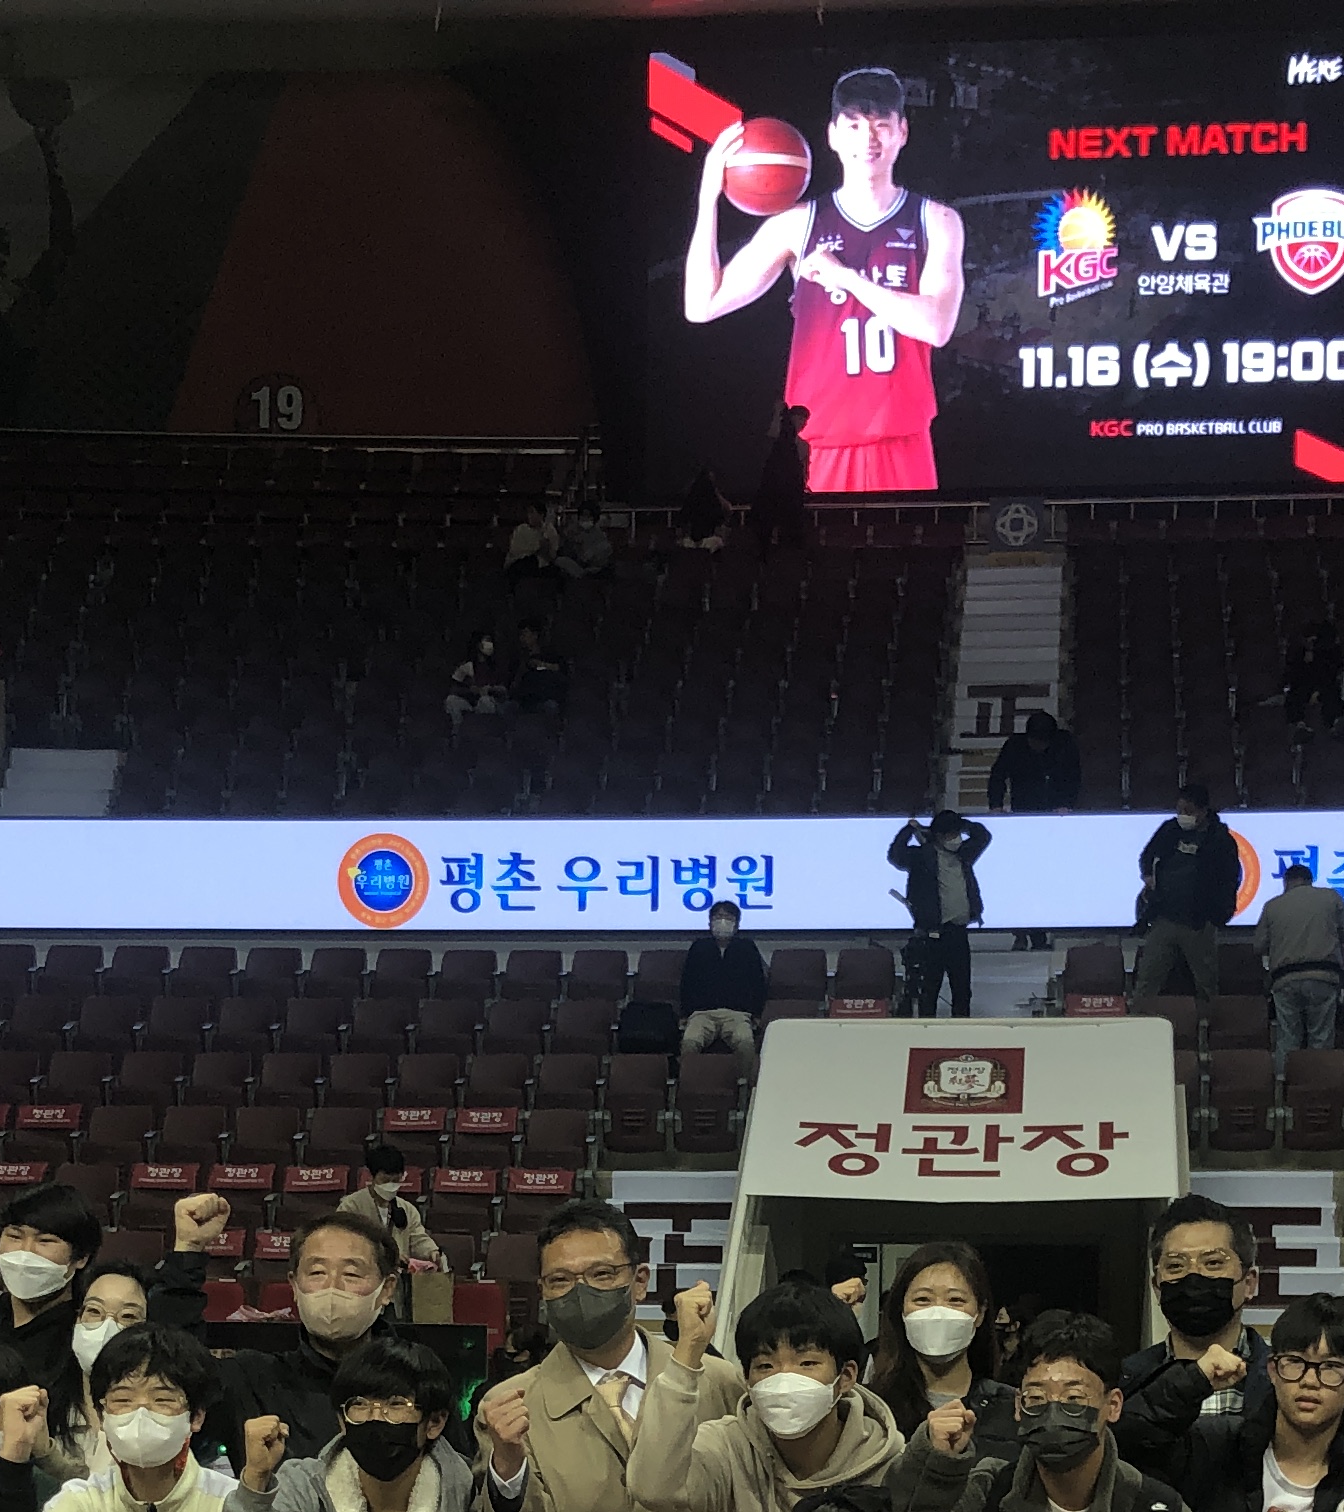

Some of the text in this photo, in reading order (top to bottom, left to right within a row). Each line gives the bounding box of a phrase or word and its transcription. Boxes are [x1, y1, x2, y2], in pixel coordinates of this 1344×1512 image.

[1050, 122, 1308, 160] NEXT MATCH
[1151, 223, 1218, 262] VS
[1038, 247, 1119, 297] KGC
[1137, 272, 1231, 295] 안양체육관
[841, 317, 896, 375] 10
[1019, 345, 1120, 389] 11.16
[1133, 341, 1210, 388] (수)
[251, 385, 304, 430] 19
[1090, 418, 1283, 437] KGC PRO BASKETBALL CLUB
[439, 852, 542, 914] 평촌
[557, 854, 774, 913] 우리병원
[795, 1121, 1130, 1178] 정관장
